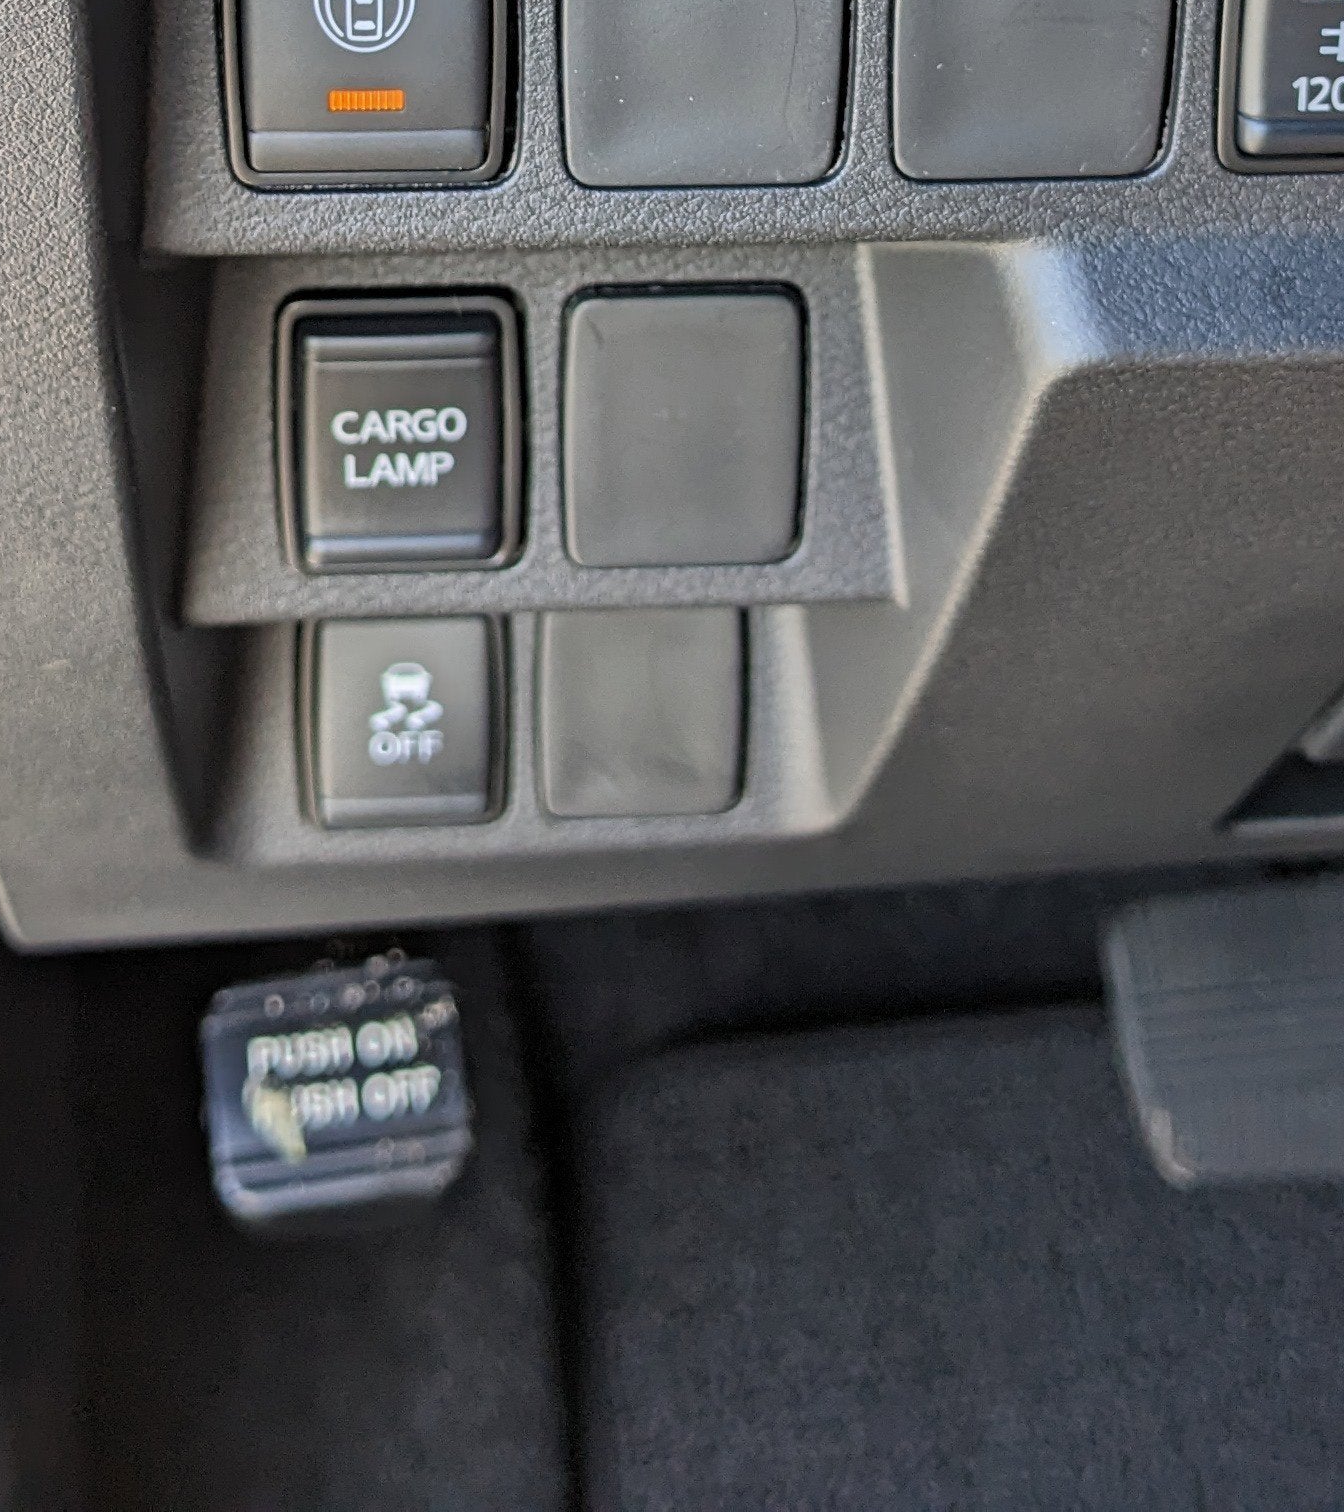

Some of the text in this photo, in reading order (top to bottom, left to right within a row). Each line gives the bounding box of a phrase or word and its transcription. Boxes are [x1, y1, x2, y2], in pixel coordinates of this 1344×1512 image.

[331, 406, 468, 445] CARGO
[343, 451, 454, 489] LAMP
[368, 730, 444, 767] OFF
[246, 1015, 419, 1080] PUSH ON
[252, 1063, 442, 1129] USH OFF
